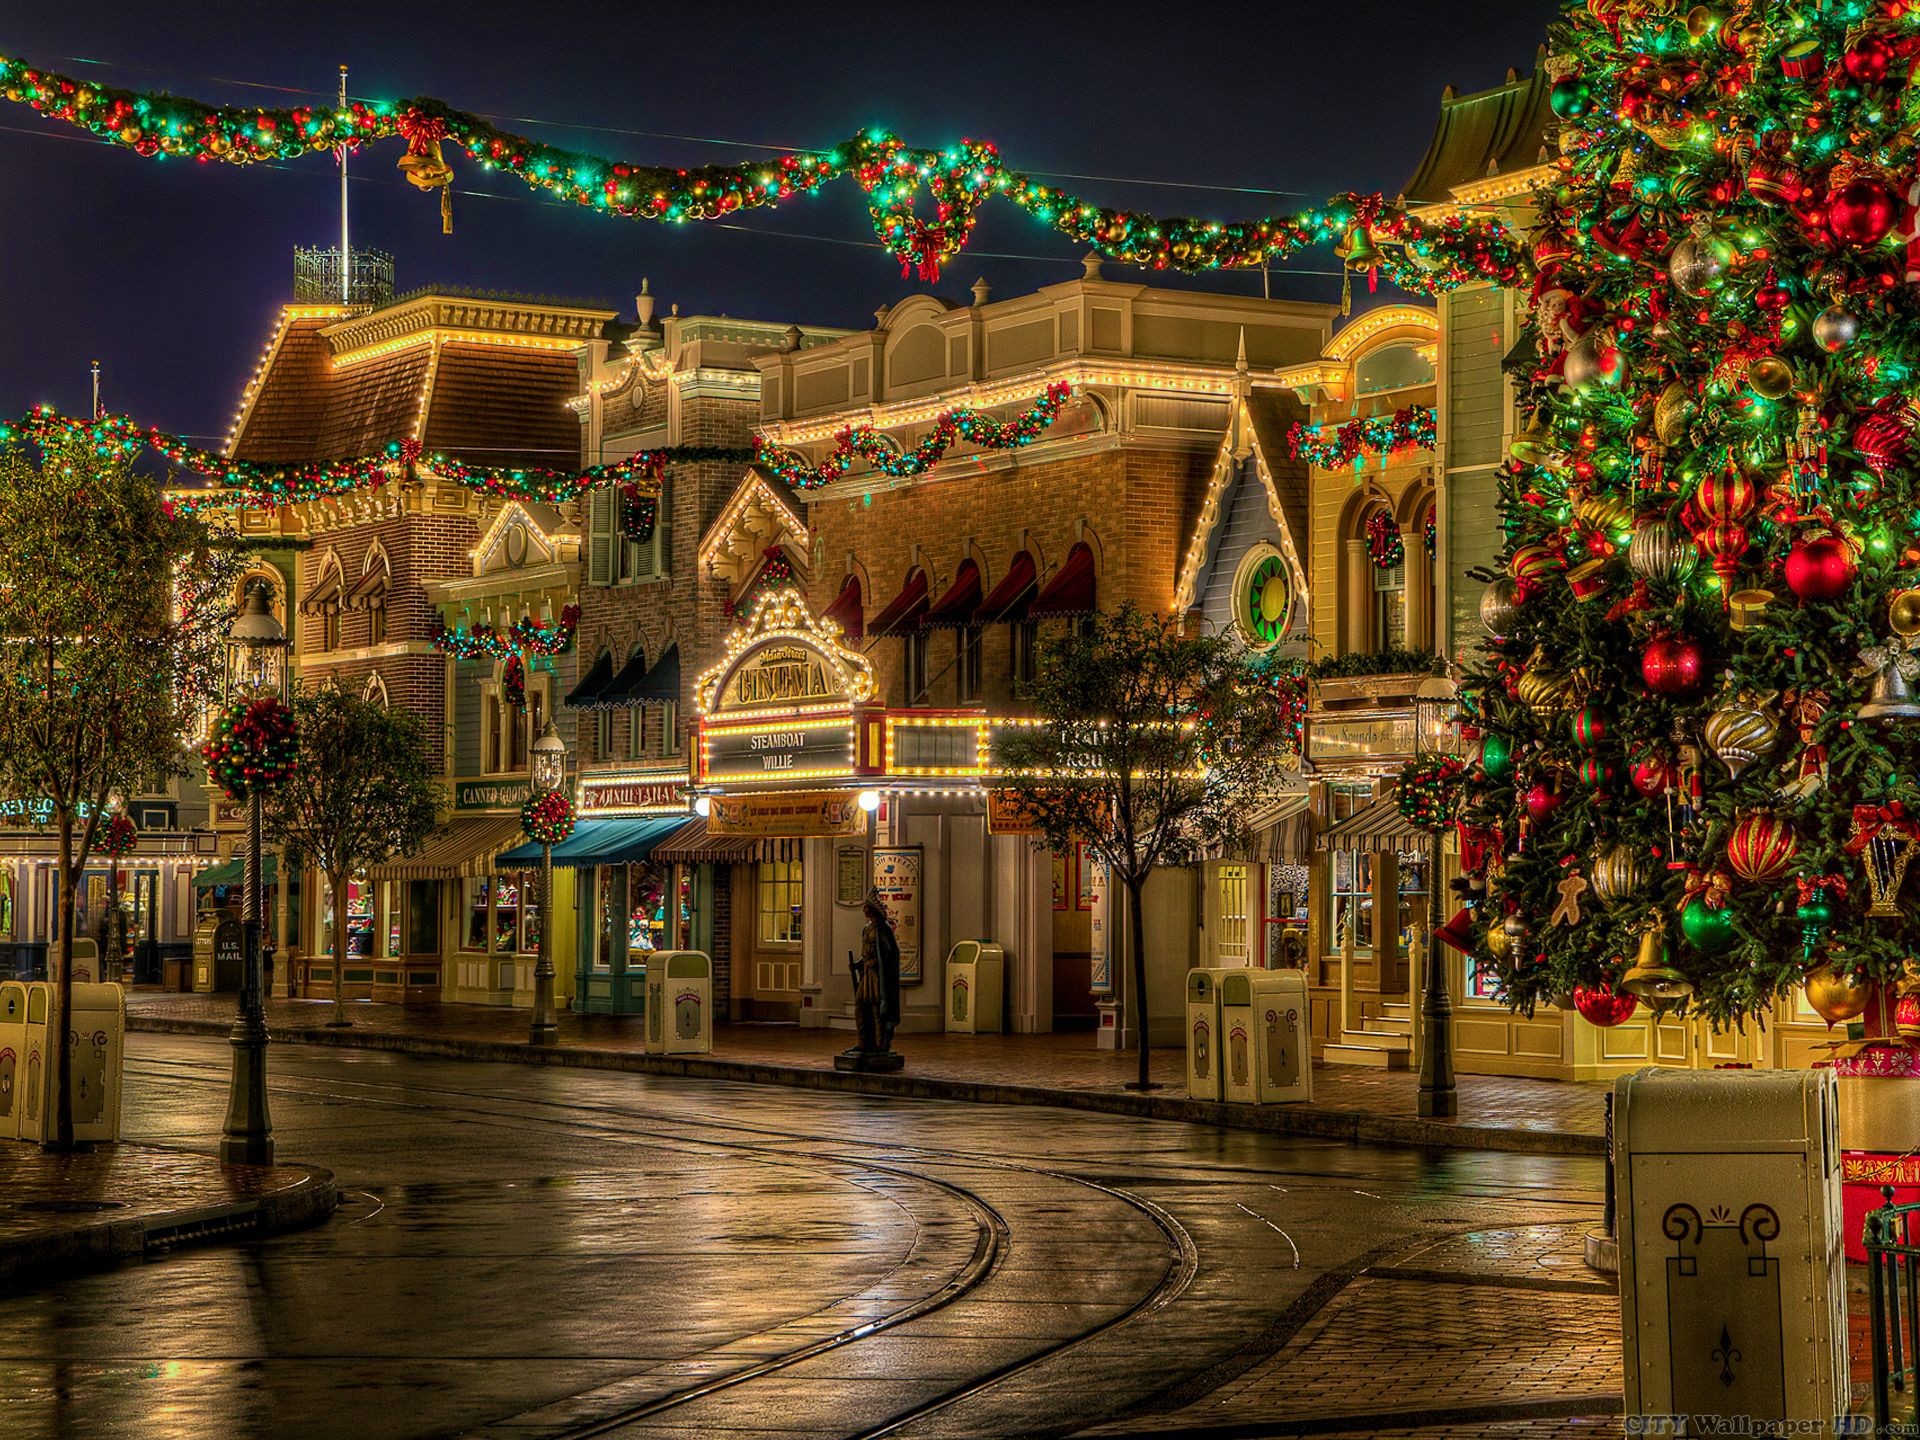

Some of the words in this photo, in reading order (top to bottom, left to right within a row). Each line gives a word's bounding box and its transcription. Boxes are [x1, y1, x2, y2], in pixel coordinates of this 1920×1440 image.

[738, 661, 830, 704] CINEMA
[750, 732, 806, 750] STEAMBOAT
[762, 754, 793, 770] WILLIE
[463, 787, 497, 804] CANNED
[875, 876, 918, 887] INEMA
[222, 941, 240, 950] U.S.
[217, 952, 243, 961] MAIL
